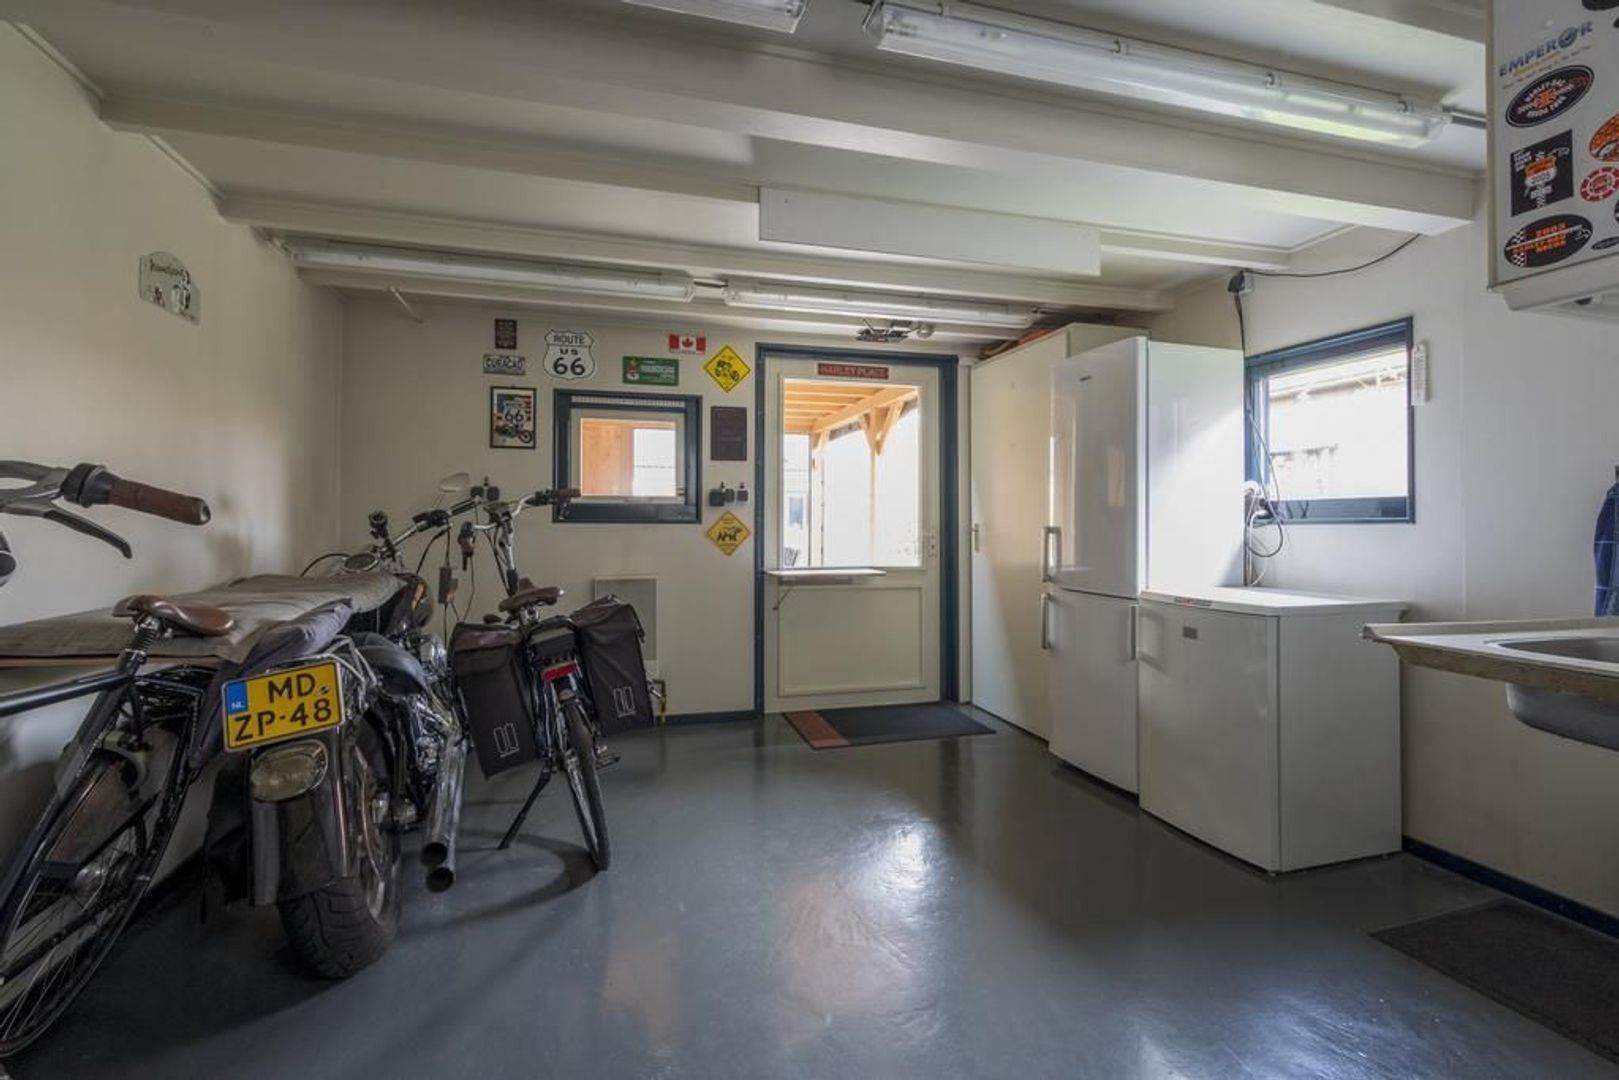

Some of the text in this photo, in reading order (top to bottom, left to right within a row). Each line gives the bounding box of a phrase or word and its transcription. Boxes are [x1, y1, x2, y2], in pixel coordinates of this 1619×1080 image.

[1499, 21, 1594, 76] EMPEROR
[553, 334, 586, 345] ROUTE
[553, 356, 586, 376] 66
[820, 366, 856, 375] HARLEY
[504, 410, 524, 422] 66
[231, 701, 245, 710] NL
[234, 698, 332, 742] ZP-48
